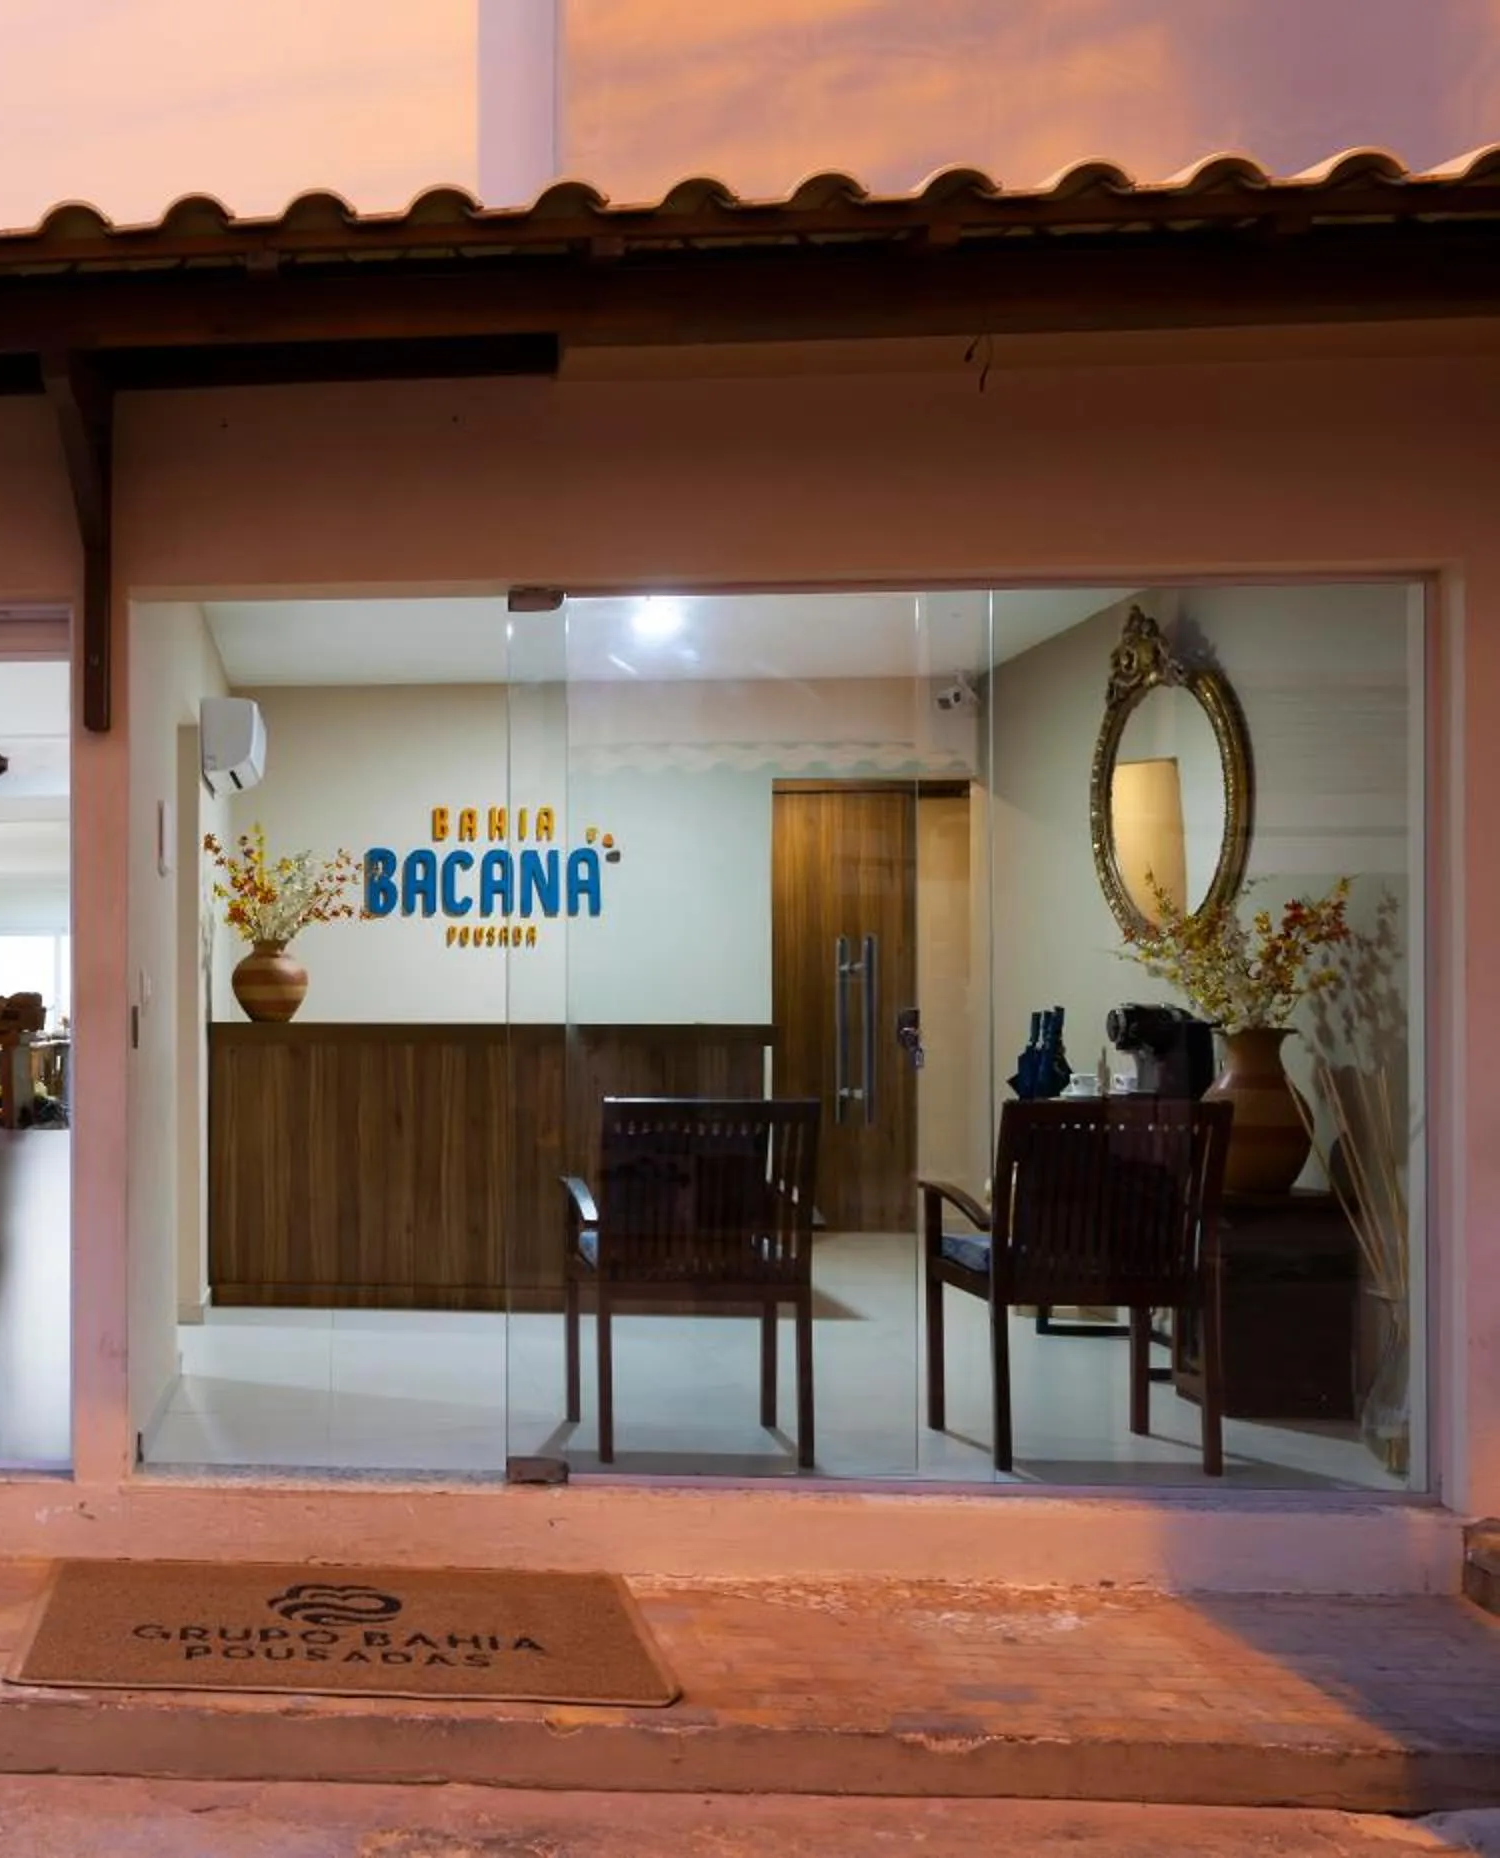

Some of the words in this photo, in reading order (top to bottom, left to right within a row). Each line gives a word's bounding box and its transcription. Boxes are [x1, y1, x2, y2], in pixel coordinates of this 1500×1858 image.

[431, 807, 554, 842] BAHIA
[364, 847, 601, 918] BACANA
[132, 1624, 339, 1644] GRUPO
[364, 1631, 545, 1652] BAHIA
[185, 1646, 492, 1668] POUSADAS
